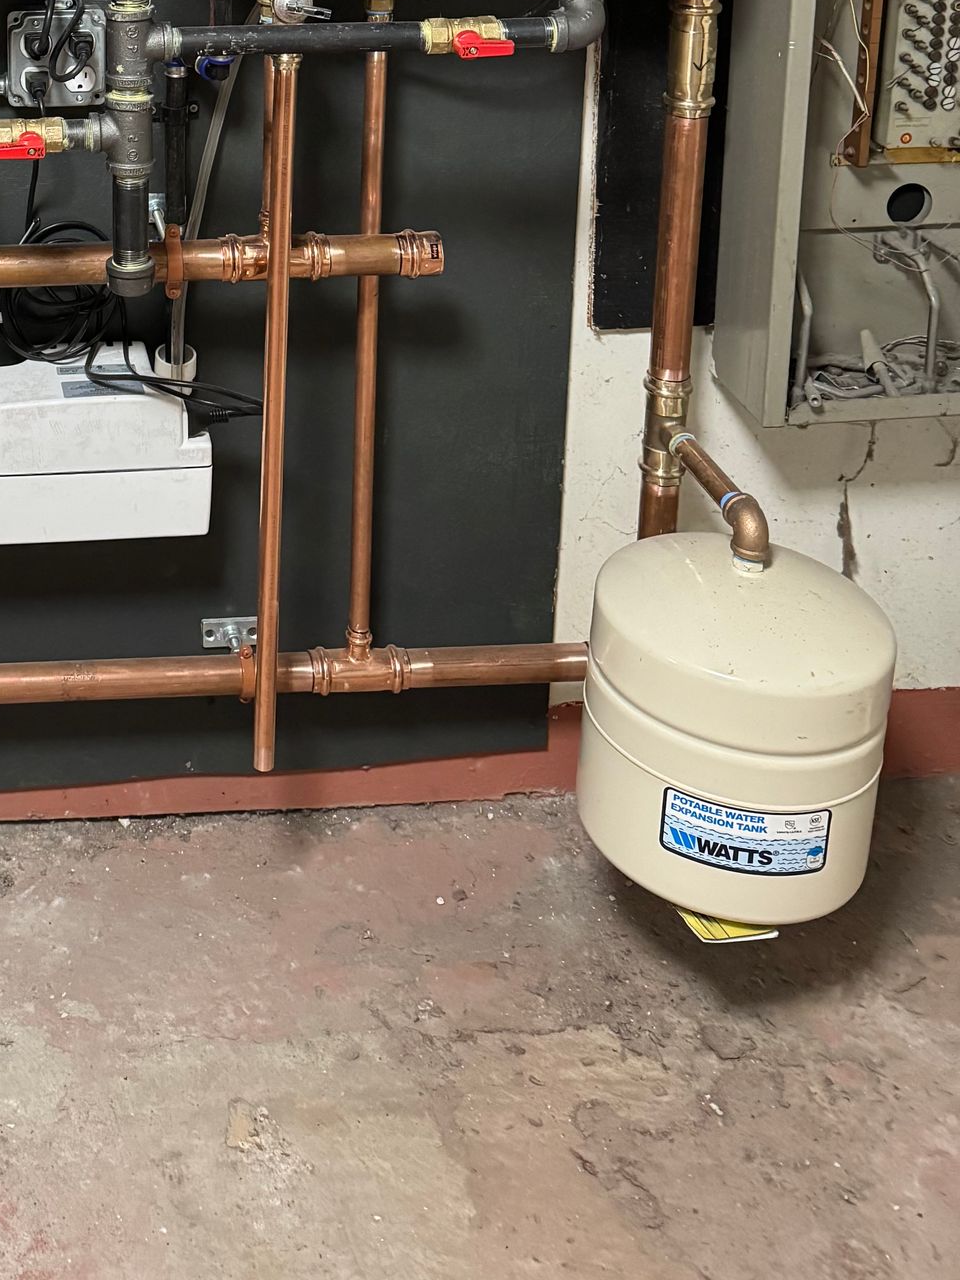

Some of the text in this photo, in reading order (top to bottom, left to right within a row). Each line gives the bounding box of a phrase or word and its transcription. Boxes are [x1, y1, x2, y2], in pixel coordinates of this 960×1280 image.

[671, 802, 768, 834] EXPANSION TANK
[673, 794, 765, 824] POTABLE WATER
